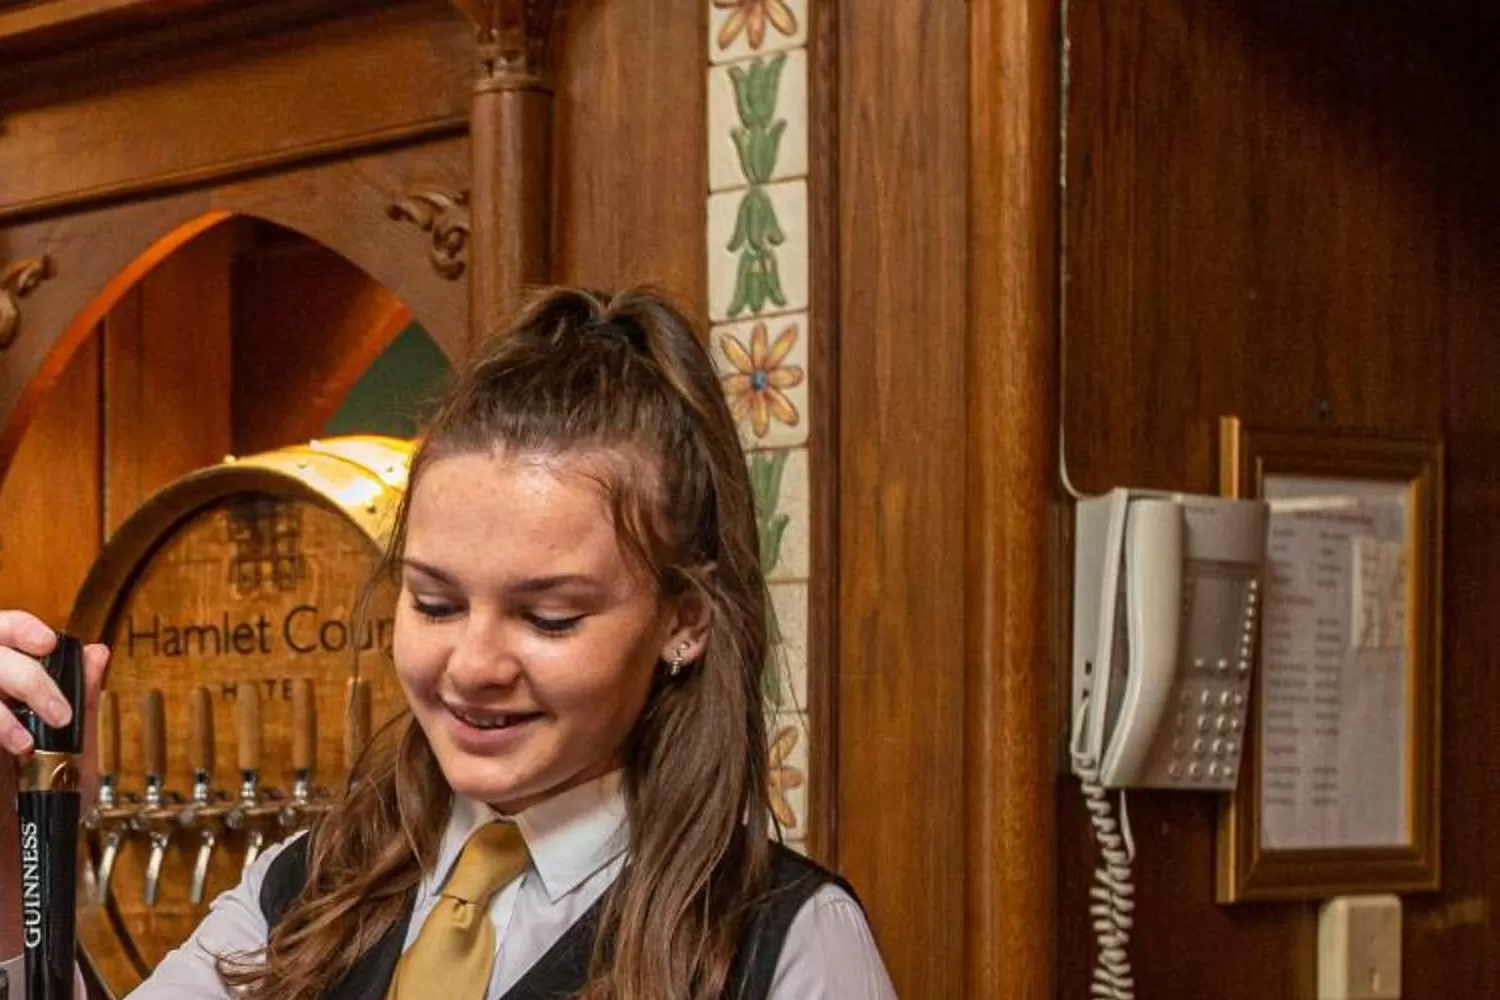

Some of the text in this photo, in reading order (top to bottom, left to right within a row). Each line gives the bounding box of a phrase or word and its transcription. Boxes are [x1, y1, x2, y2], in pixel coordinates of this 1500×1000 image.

[126, 604, 395, 658] Hamlet Cour
[222, 677, 314, 702] HTE
[21, 821, 41, 949] GUINNESS
